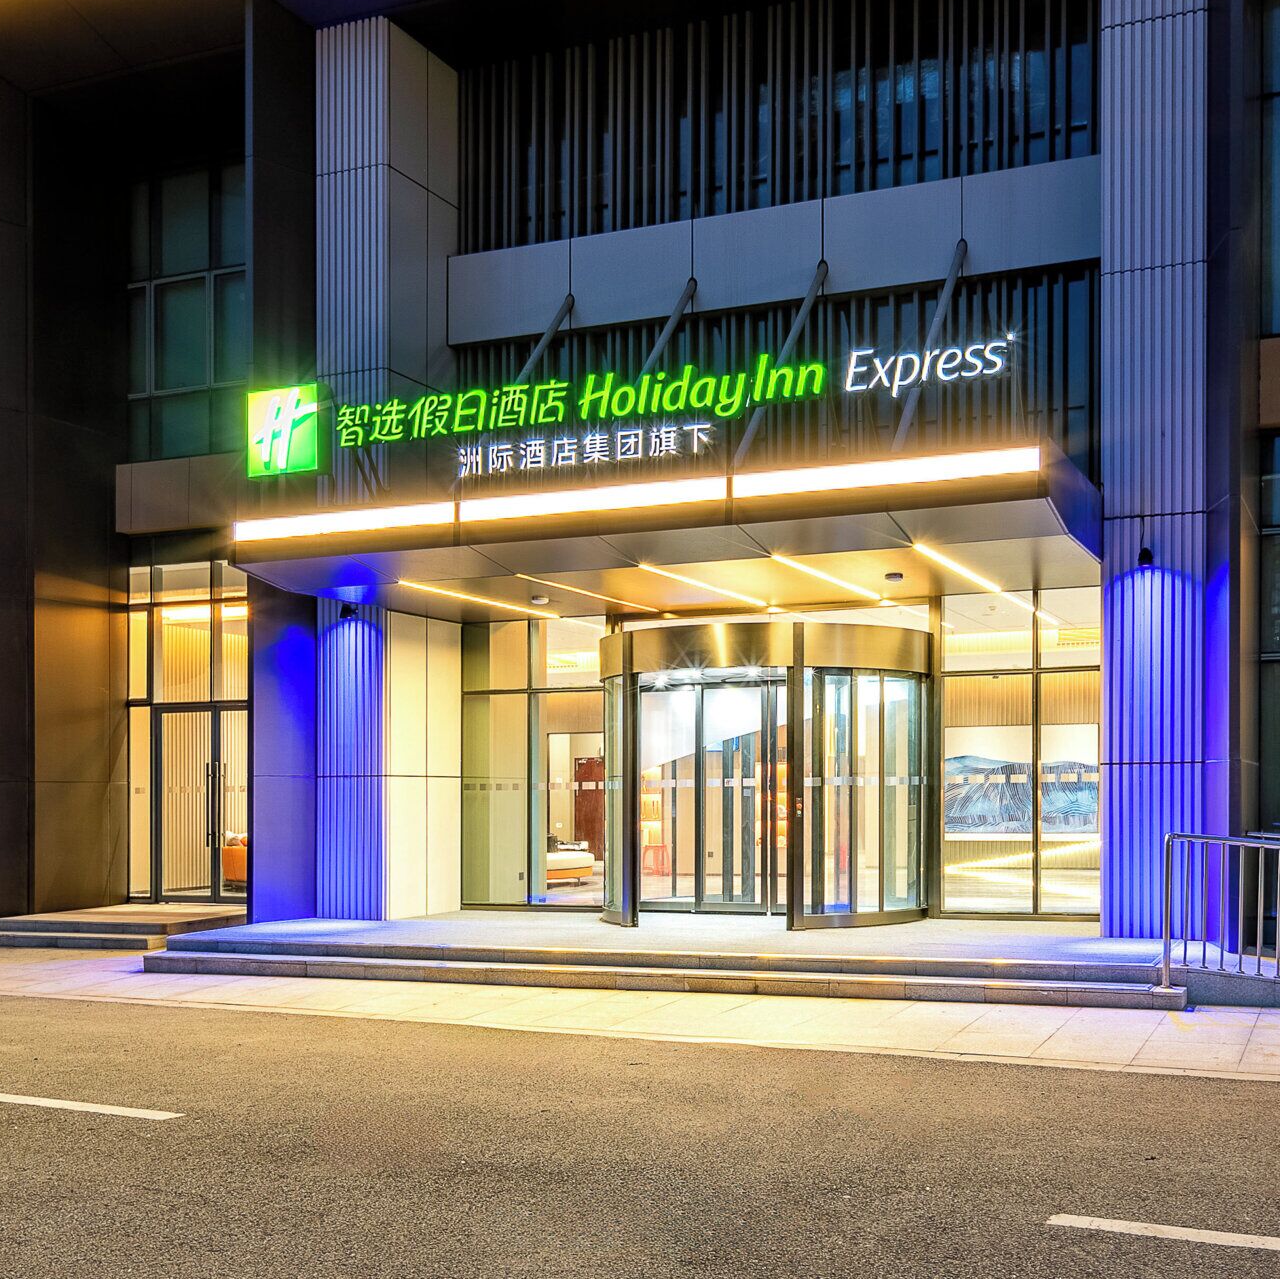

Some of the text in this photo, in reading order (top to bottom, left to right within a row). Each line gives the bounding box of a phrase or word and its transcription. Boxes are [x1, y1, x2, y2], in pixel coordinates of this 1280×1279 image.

[578, 340, 1008, 417] Holiday Inn Express
[335, 380, 569, 447] 智选假日酒店
[458, 423, 712, 477] 洲际酒店集团旗下
